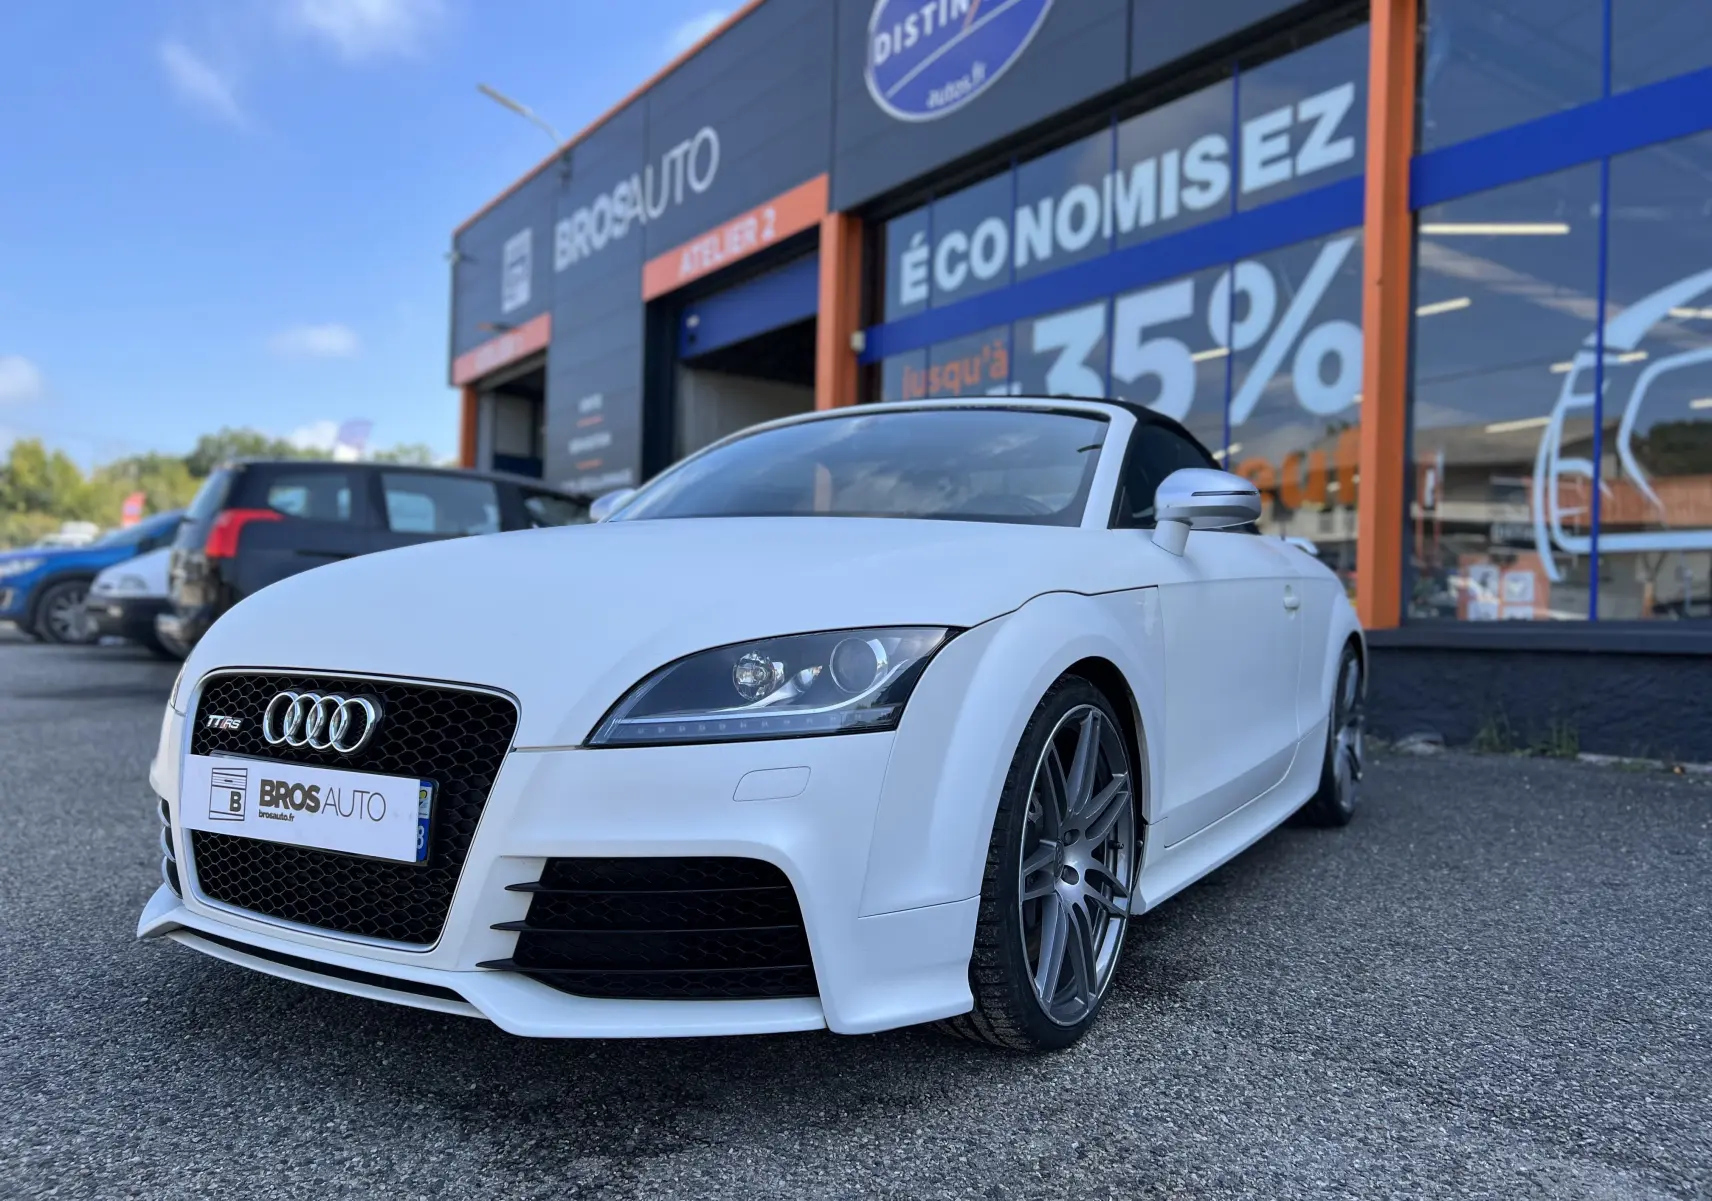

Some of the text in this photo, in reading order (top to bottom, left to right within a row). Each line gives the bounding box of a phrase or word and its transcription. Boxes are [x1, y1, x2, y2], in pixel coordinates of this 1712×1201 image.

[899, 84, 1356, 305] ÉCONOMISEZ
[680, 208, 777, 275] ATELIER 2
[258, 811, 296, 822] brosauto.fr
